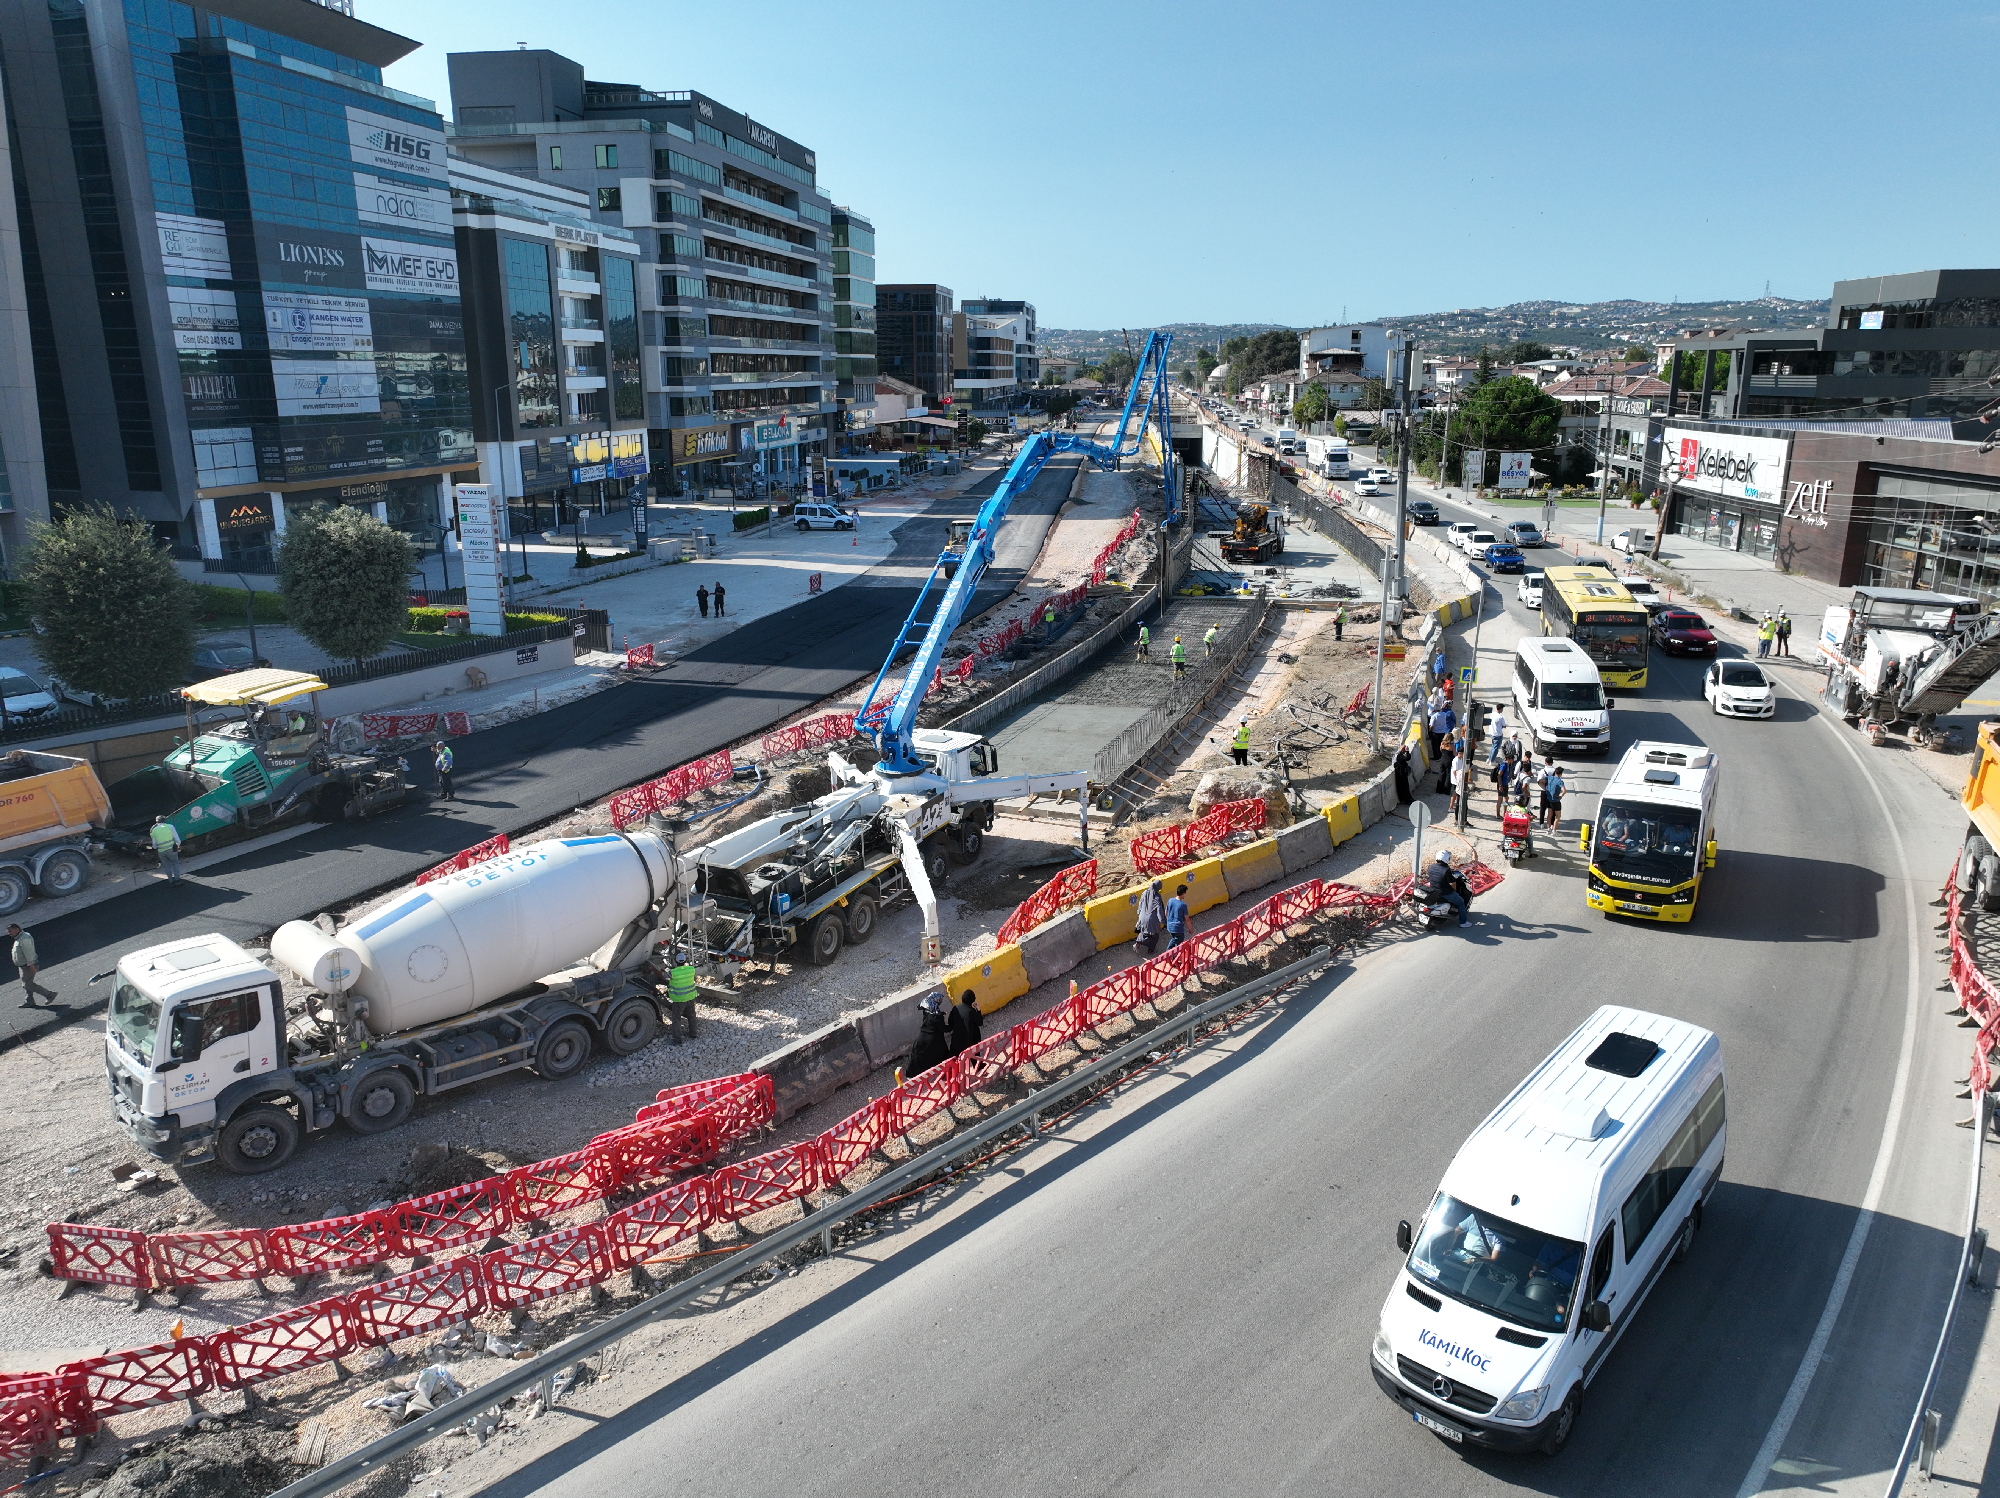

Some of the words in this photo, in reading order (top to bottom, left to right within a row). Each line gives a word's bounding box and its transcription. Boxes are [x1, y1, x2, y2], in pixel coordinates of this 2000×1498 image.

[384, 132, 431, 161] HSG
[750, 124, 776, 150] AKARSU
[278, 241, 345, 268] LIONESS
[303, 269, 328, 283] group
[390, 255, 422, 277] MEF
[425, 259, 455, 281] GYD
[310, 313, 339, 323] KANGEN
[340, 315, 364, 324] WATER
[696, 430, 728, 455] istikbal
[1700, 447, 1758, 484] Kelebek
[340, 481, 389, 498] Efendioğlu
[1784, 480, 1829, 519] Zett
[897, 661, 925, 709] BETON
[15, 793, 35, 804] 760
[925, 803, 941, 826] 42
[260, 1057, 269, 1066] 2
[1420, 1414, 1429, 1425] 16
[1442, 1425, 1461, 1440] 2534
